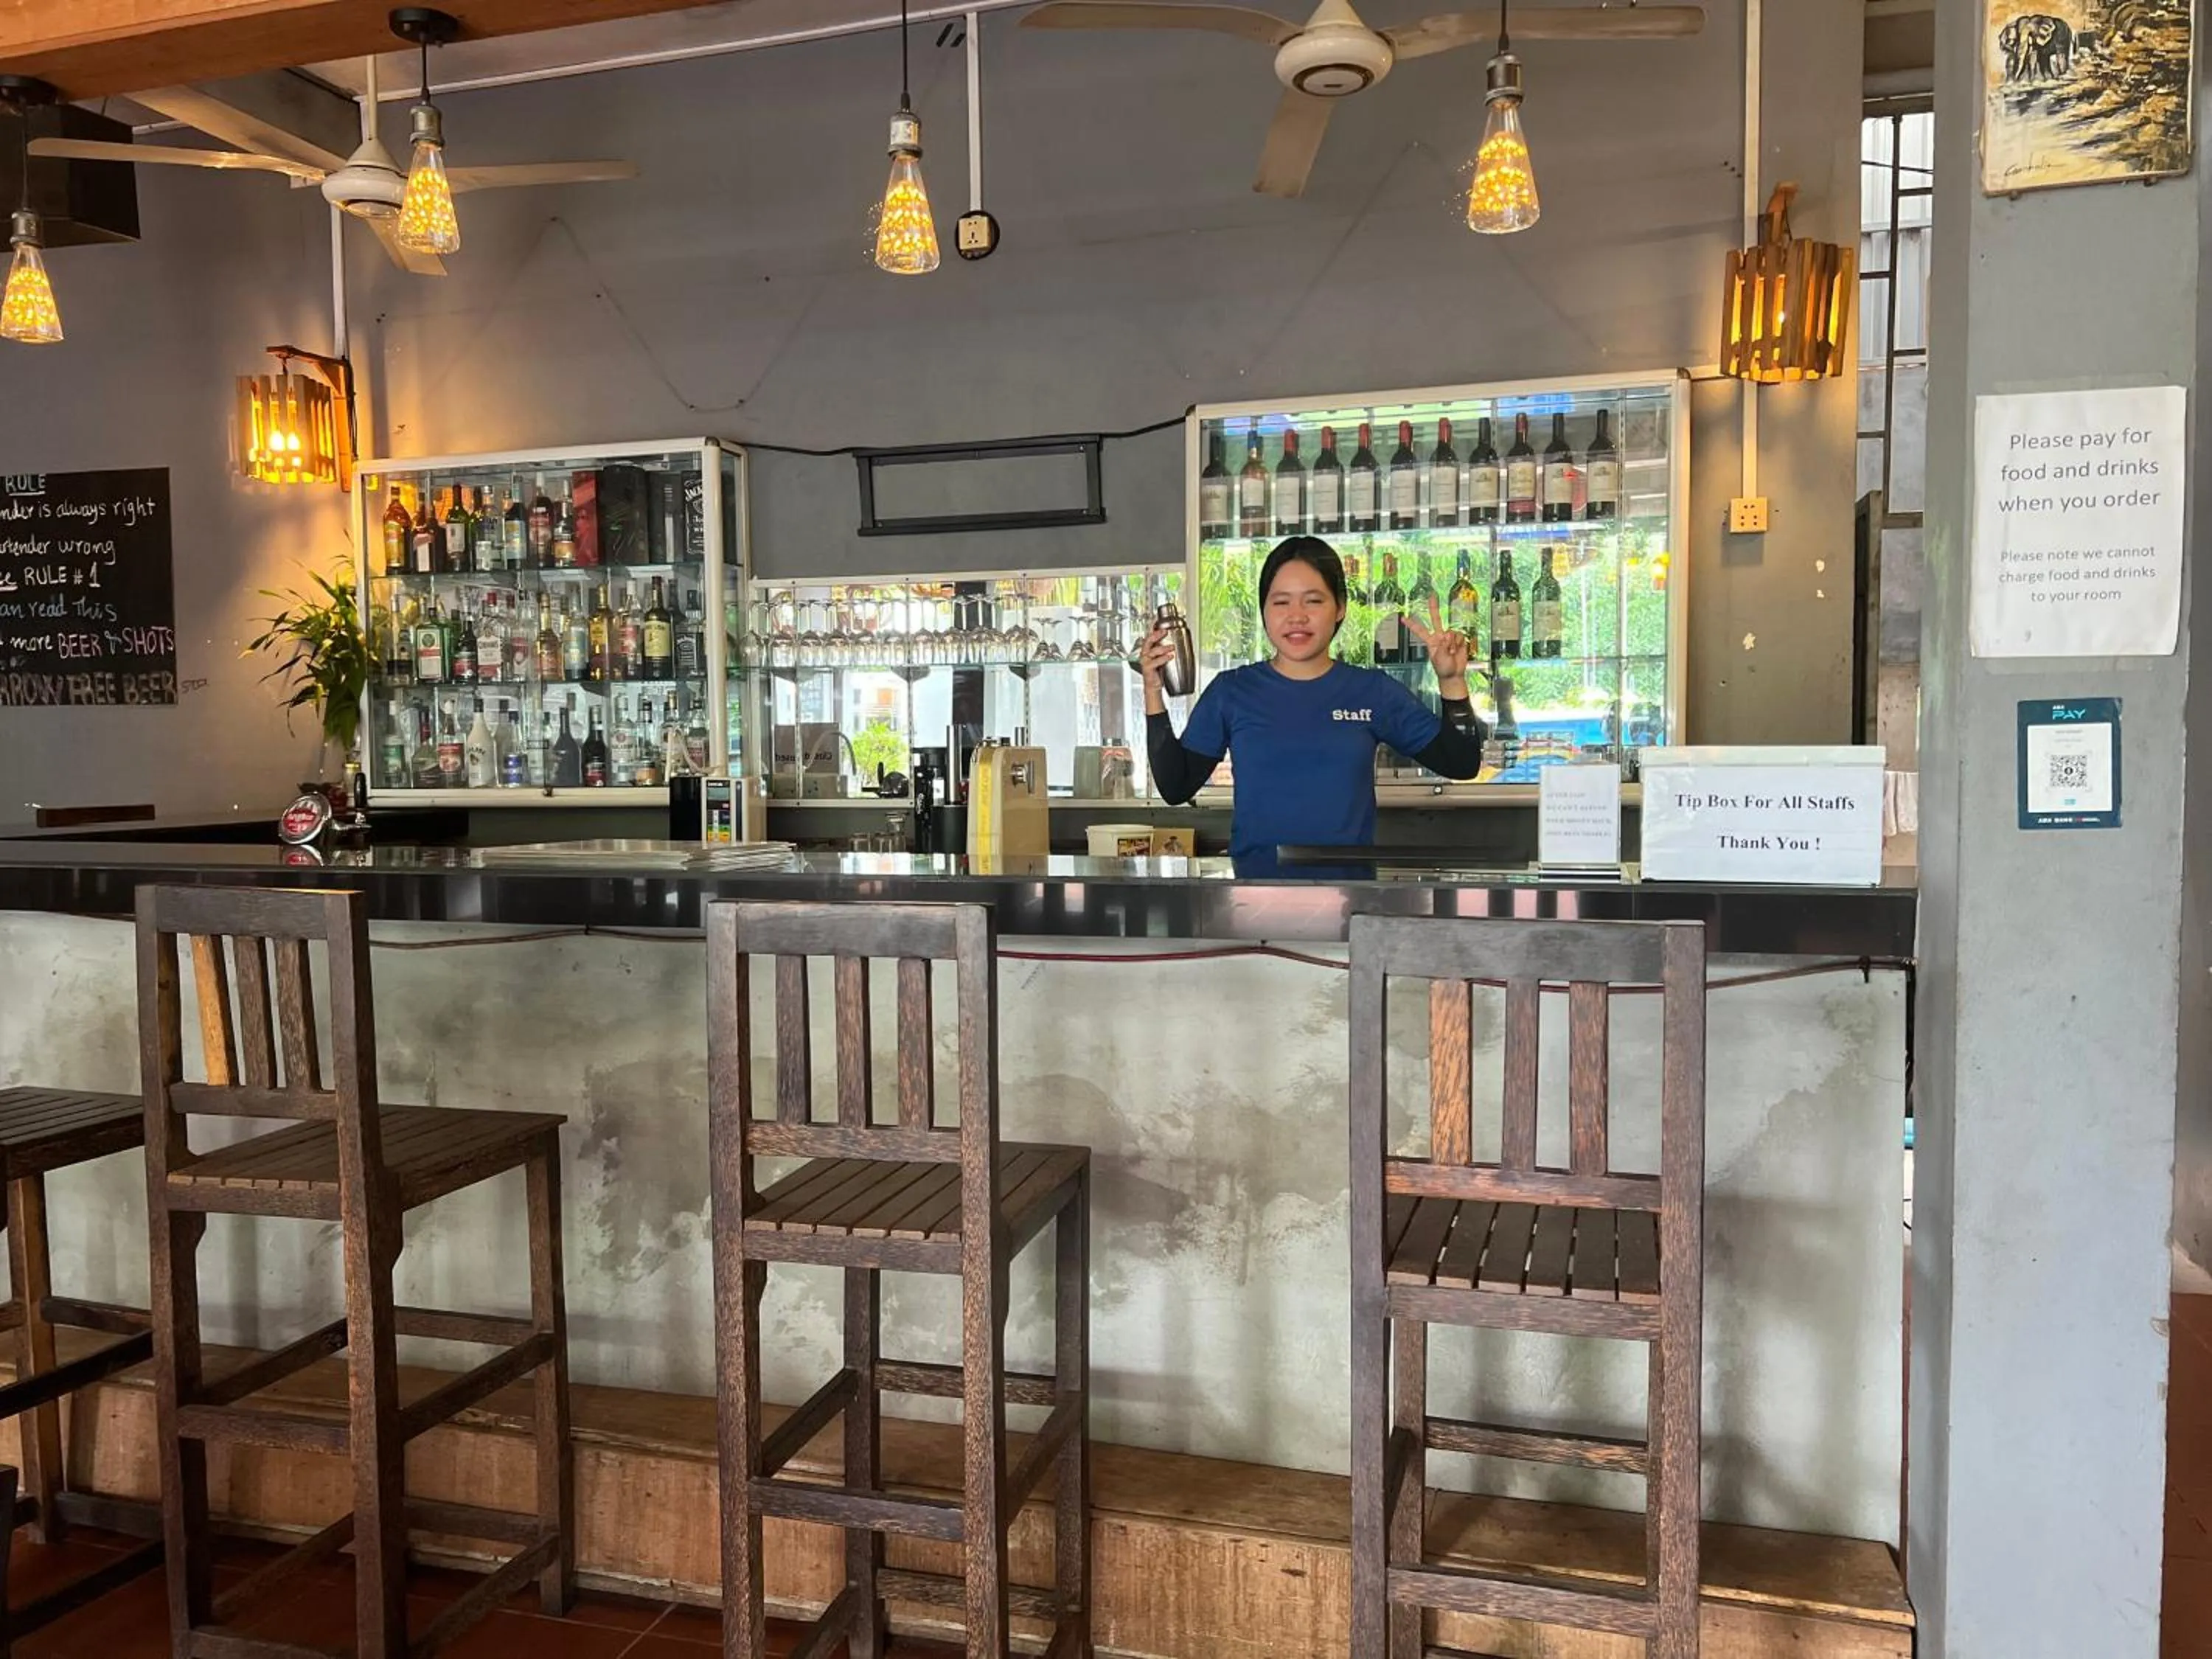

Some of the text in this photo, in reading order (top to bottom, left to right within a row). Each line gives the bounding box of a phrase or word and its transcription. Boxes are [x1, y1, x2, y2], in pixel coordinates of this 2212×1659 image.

[2009, 427, 2152, 451] Please pay for
[2001, 458, 2160, 481] food and drinks
[5, 474, 46, 493] RULE
[38, 501, 51, 518] is
[56, 498, 107, 525] always
[113, 496, 156, 526] right
[1998, 490, 2160, 513] when you order
[58, 540, 116, 566] wrong
[2000, 546, 2155, 563] Please note we cannot
[24, 564, 67, 585] RULE
[1999, 565, 2156, 585] charge food and drinks
[28, 592, 68, 617] read
[2031, 589, 2121, 603] to your room
[10, 635, 53, 651] more
[58, 633, 102, 658] BEER
[122, 626, 174, 655] SHOTS
[66, 672, 116, 704] FREE
[122, 669, 178, 704] BEER
[1332, 709, 1372, 722] Staff
[2052, 709, 2086, 720] PAY
[1674, 794, 1855, 810] Tip Box For All Staffs
[1717, 835, 1821, 851] Thank You !
